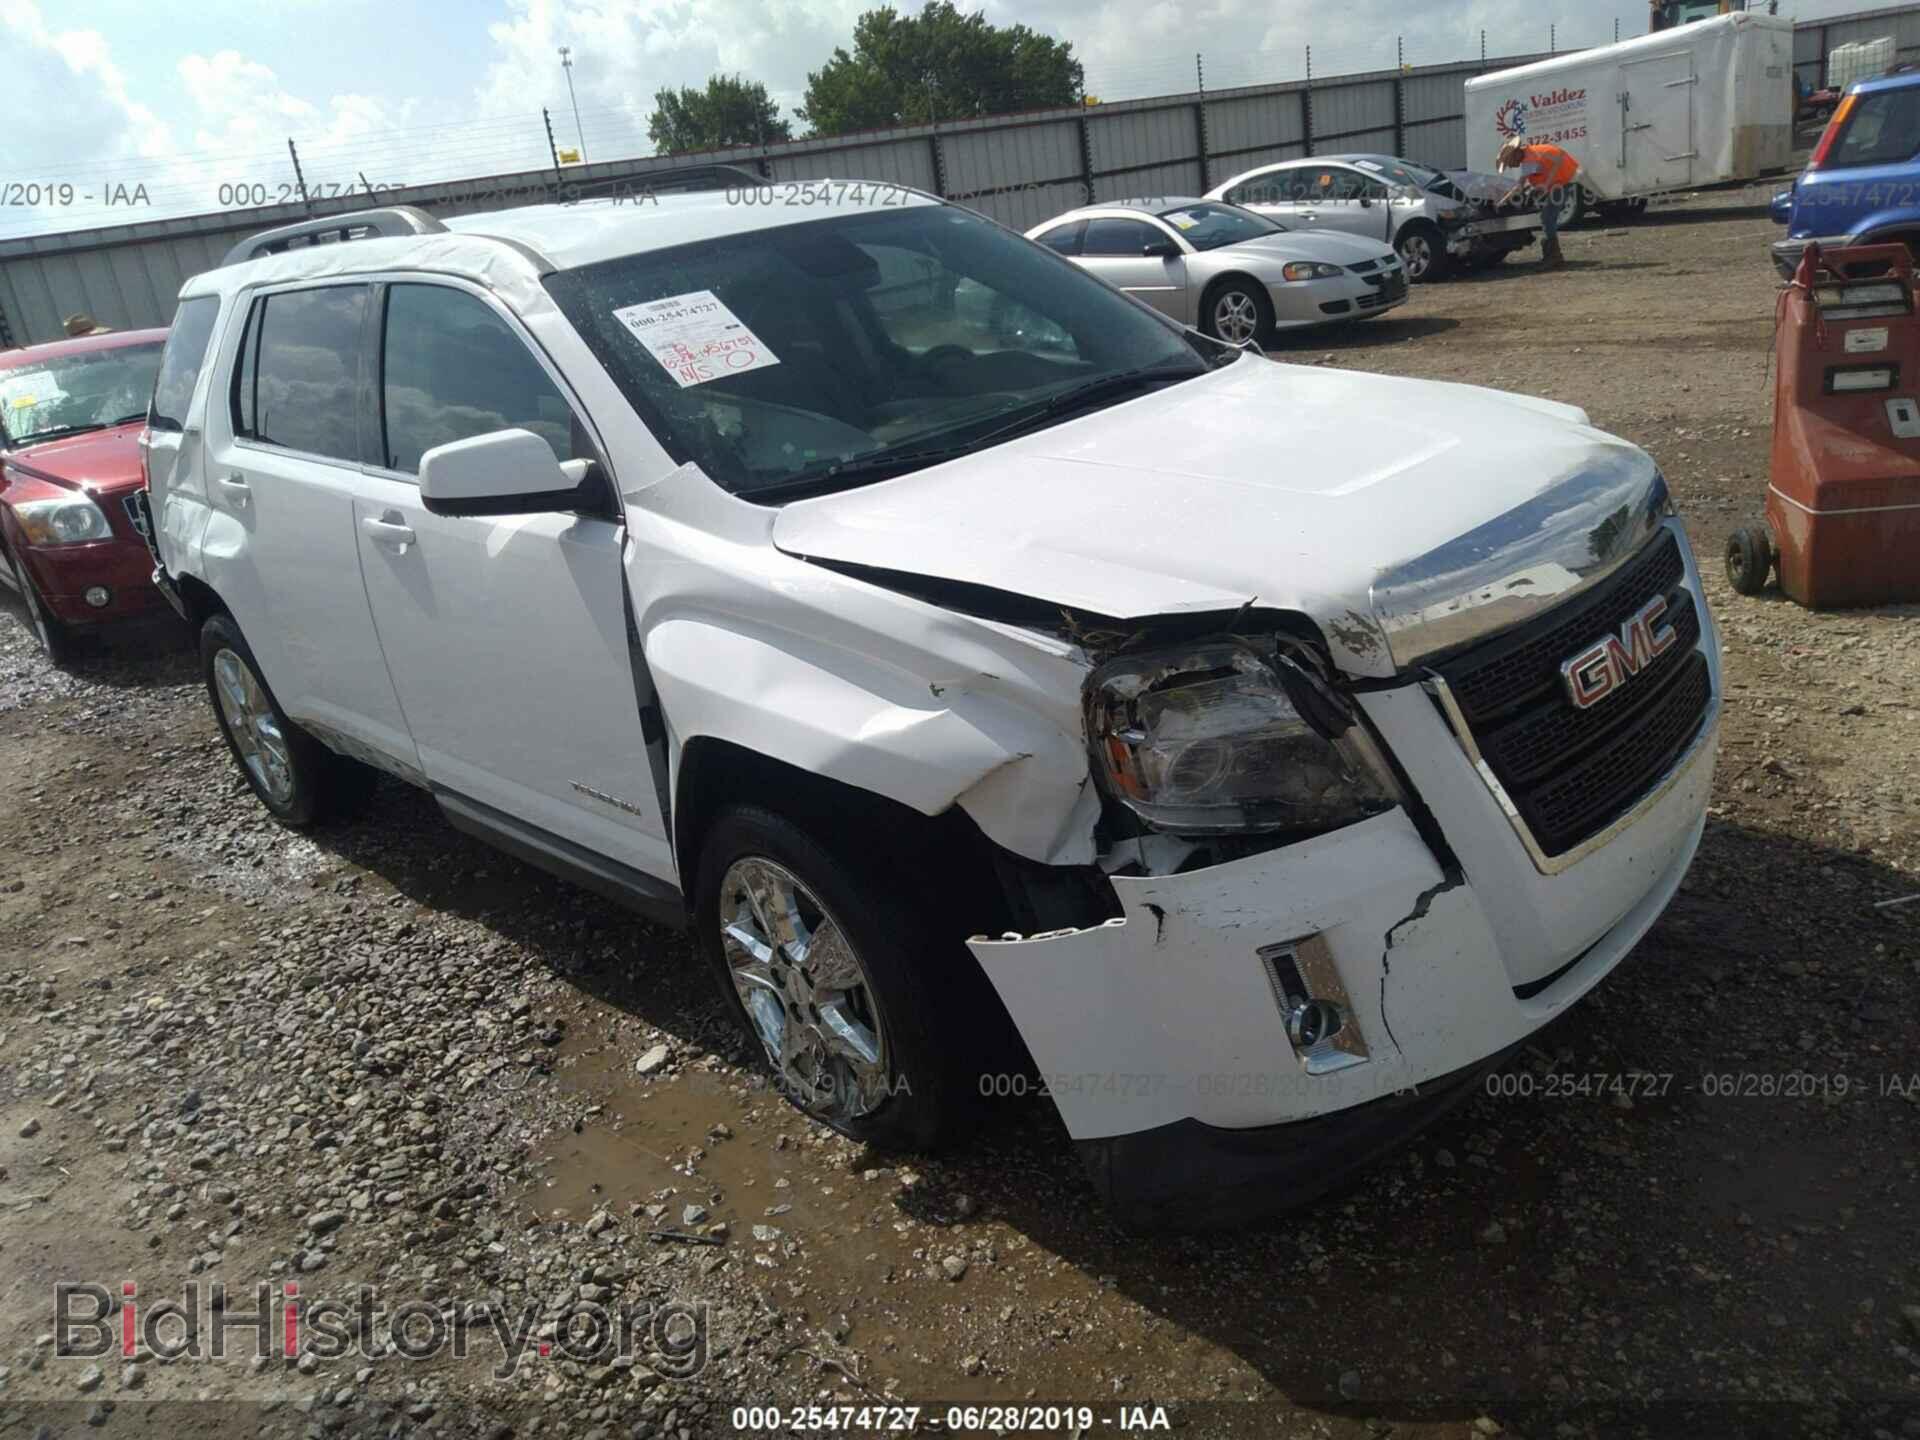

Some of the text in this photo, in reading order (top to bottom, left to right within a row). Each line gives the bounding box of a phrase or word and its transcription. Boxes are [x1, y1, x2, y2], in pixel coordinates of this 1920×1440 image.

[1530, 88, 1585, 108] Valdez
[630, 302, 718, 328] 000-25474727
[1561, 594, 1677, 709] GMC
